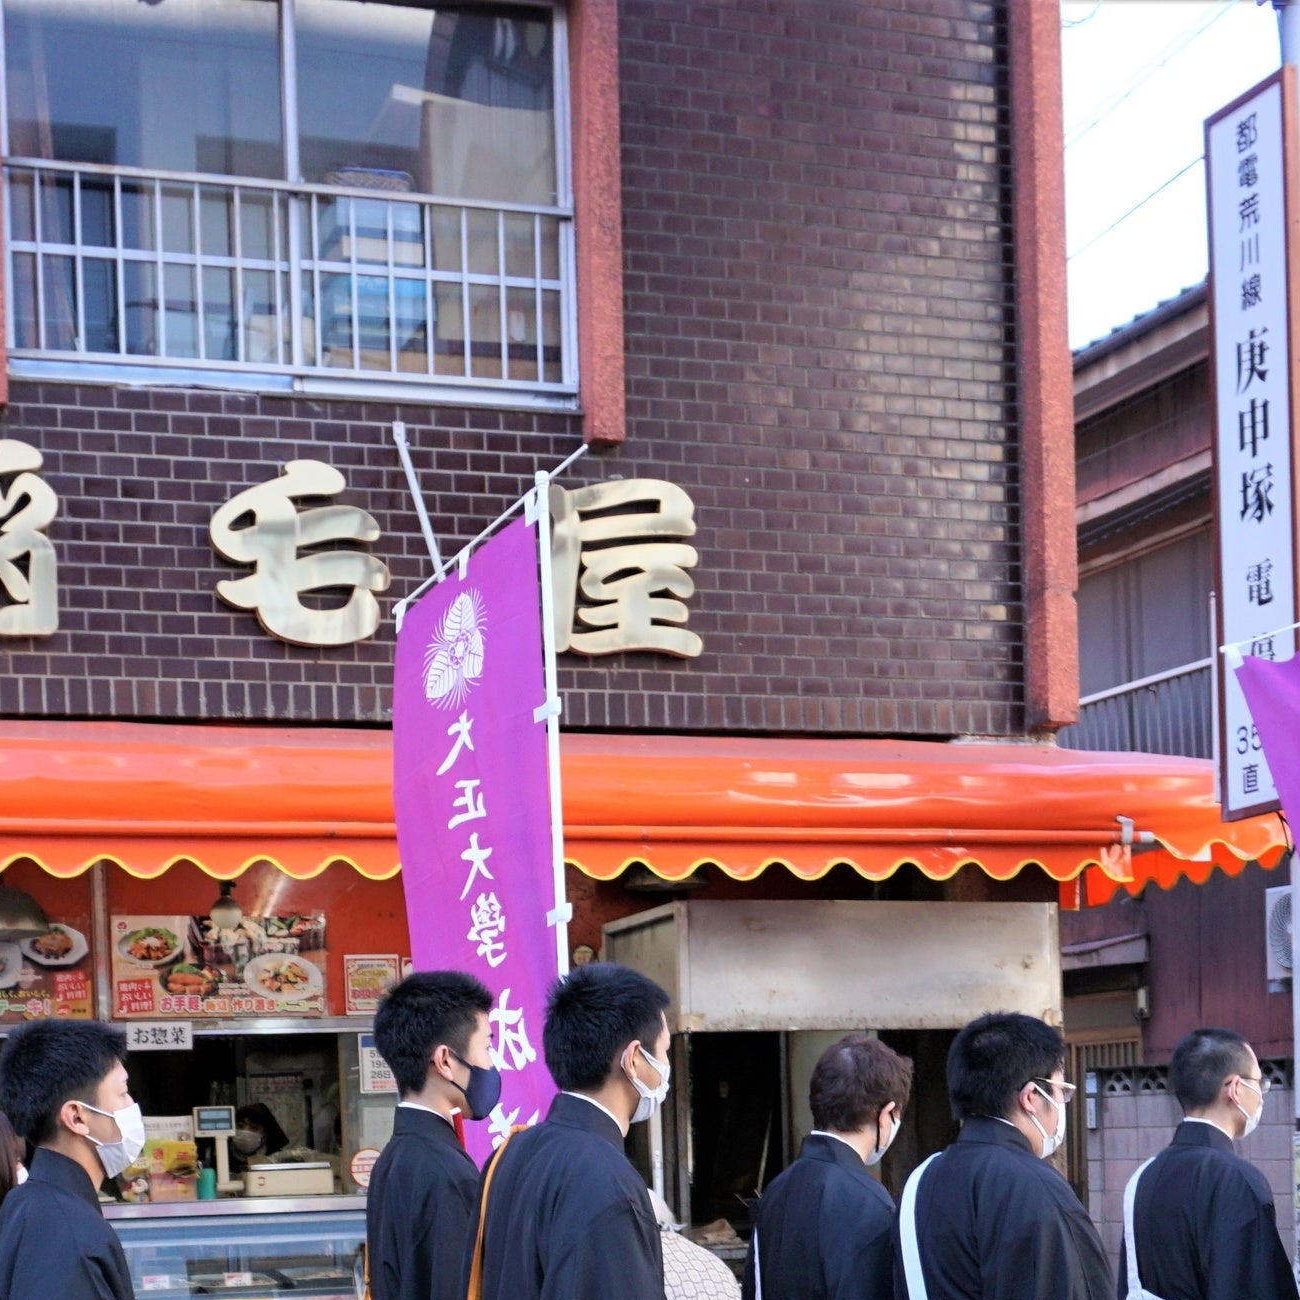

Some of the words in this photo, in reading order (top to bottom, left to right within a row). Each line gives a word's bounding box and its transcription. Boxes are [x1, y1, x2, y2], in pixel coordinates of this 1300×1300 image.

[1235, 112, 1263, 311] 都電荒川線
[1236, 328, 1275, 523] 庚申塚
[132, 1026, 186, 1046] お惣菜
